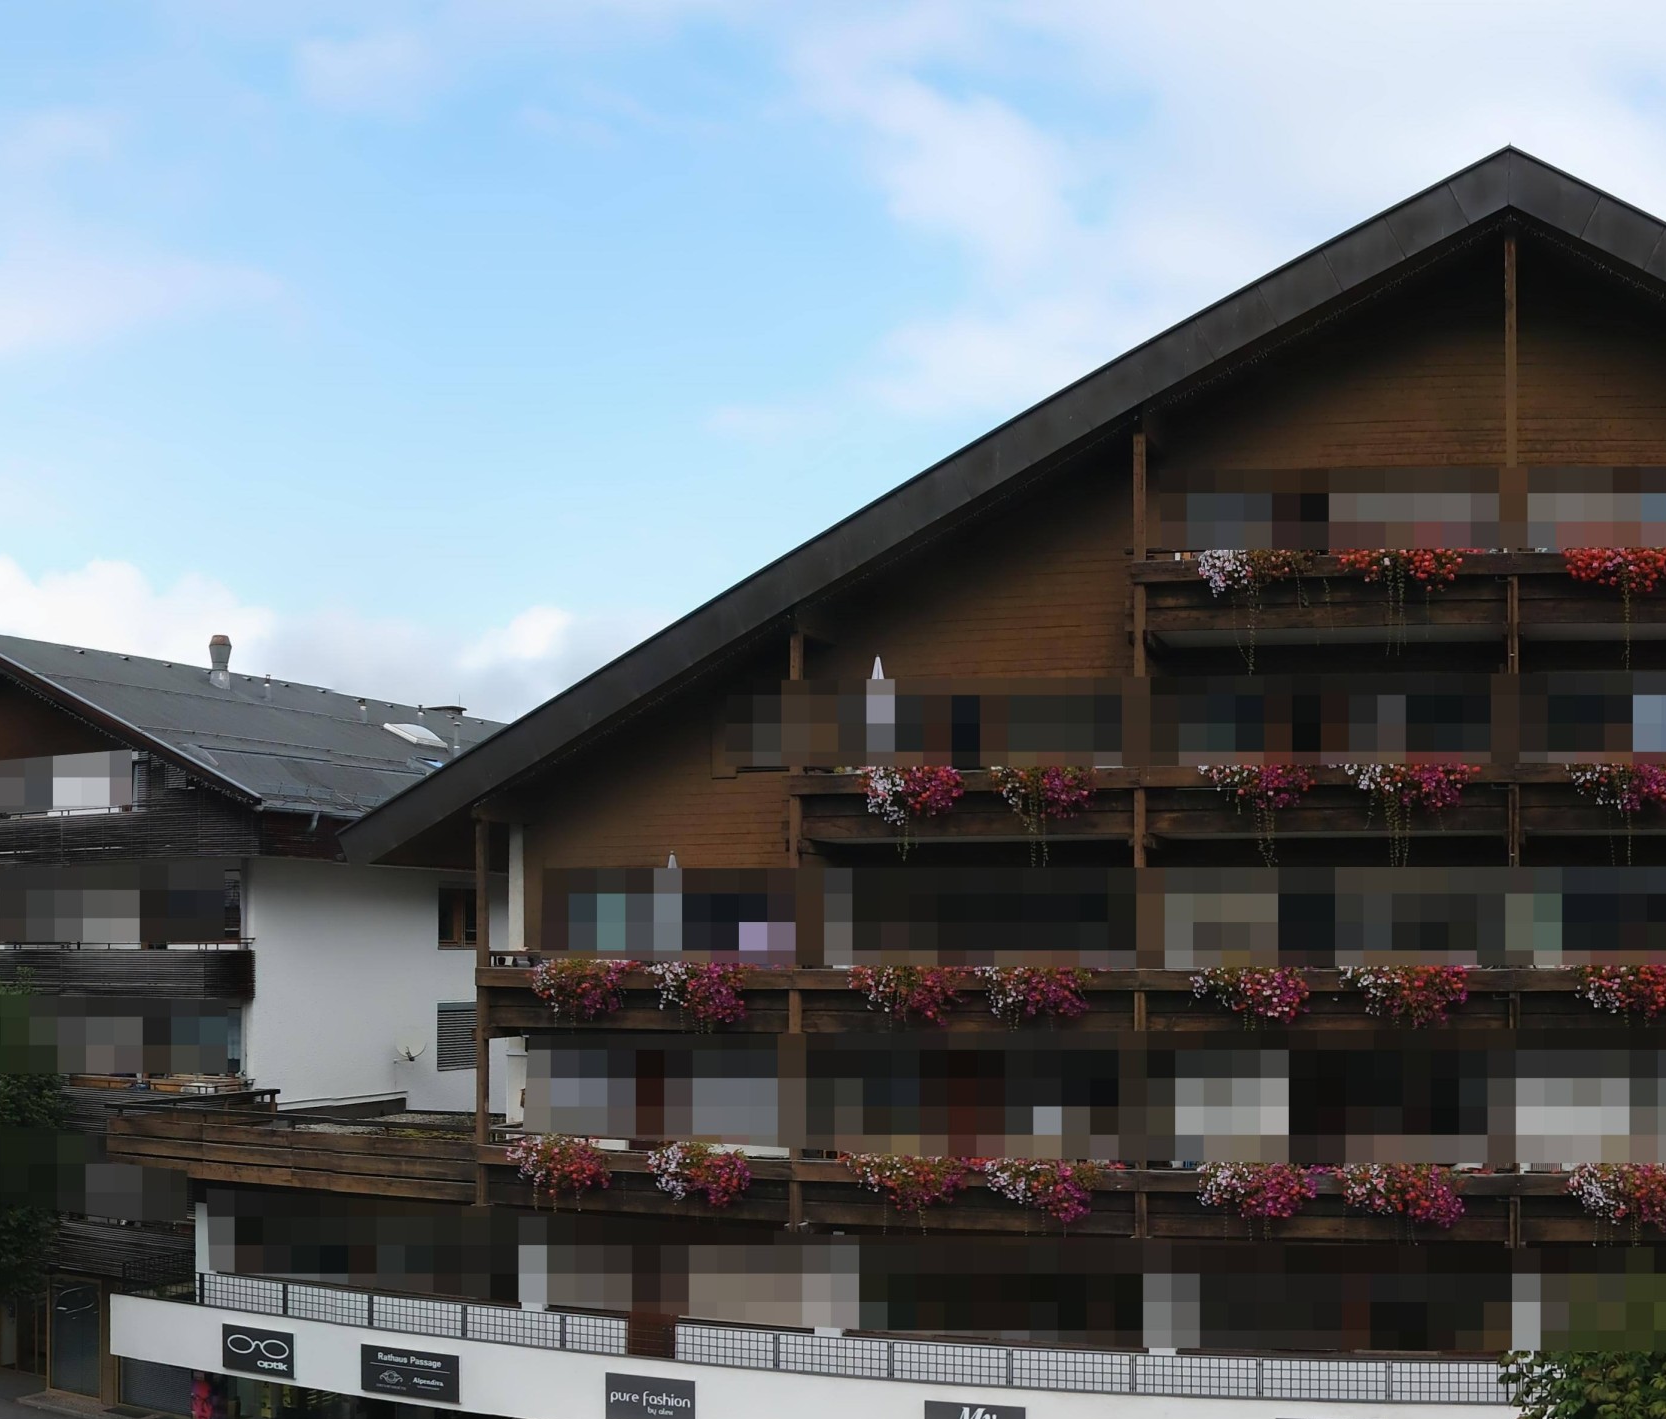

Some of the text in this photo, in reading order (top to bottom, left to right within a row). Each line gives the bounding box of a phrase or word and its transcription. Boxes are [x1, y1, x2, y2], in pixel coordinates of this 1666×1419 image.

[257, 1360, 288, 1372] optik
[378, 1352, 442, 1369] Rathaus Passage
[413, 1376, 445, 1387] Alpendiva
[610, 1391, 691, 1409] pure fashion
[647, 1406, 657, 1416] by
